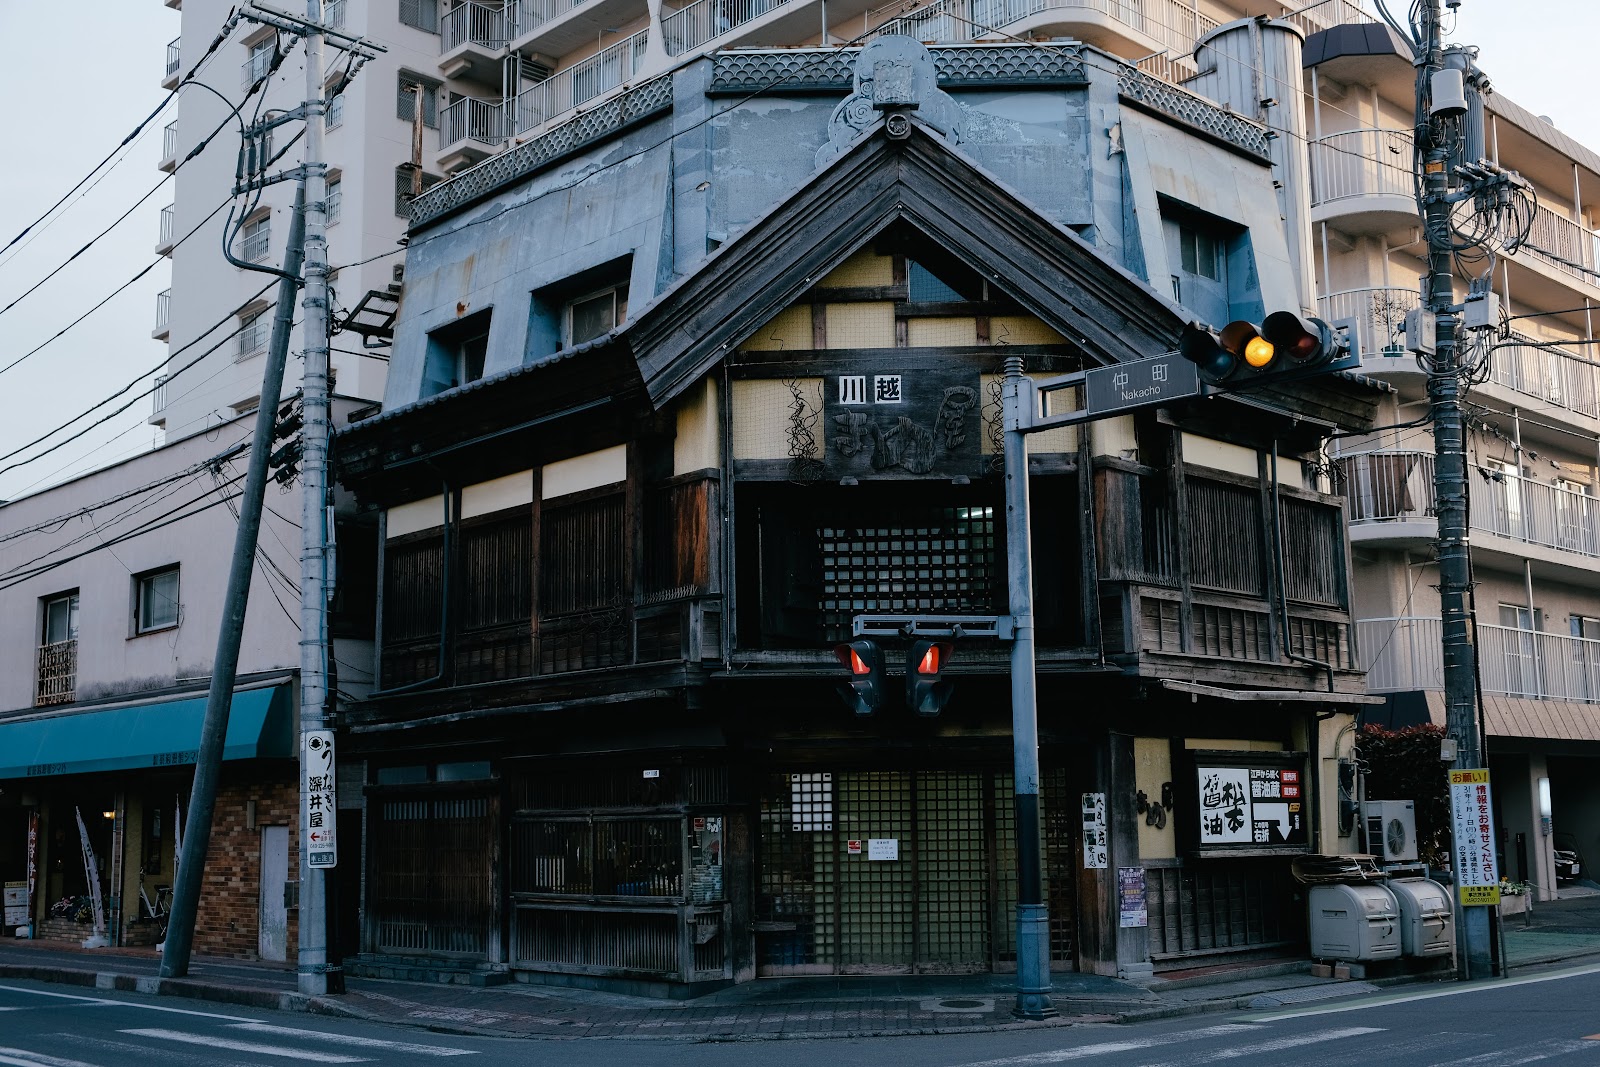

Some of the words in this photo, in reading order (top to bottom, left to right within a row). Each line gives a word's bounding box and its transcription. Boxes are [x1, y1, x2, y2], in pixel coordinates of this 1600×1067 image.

[841, 376, 901, 403] 川越
[1112, 363, 1168, 392] 仲町
[1121, 384, 1161, 401] Nakacho
[321, 740, 334, 813] うなぎ
[1251, 780, 1281, 798] 醤油蔵
[309, 775, 323, 828] 深井屋
[1221, 780, 1245, 834] 松本
[1254, 829, 1270, 843] 右折
[1475, 784, 1495, 885] 情報をお寄せください。
